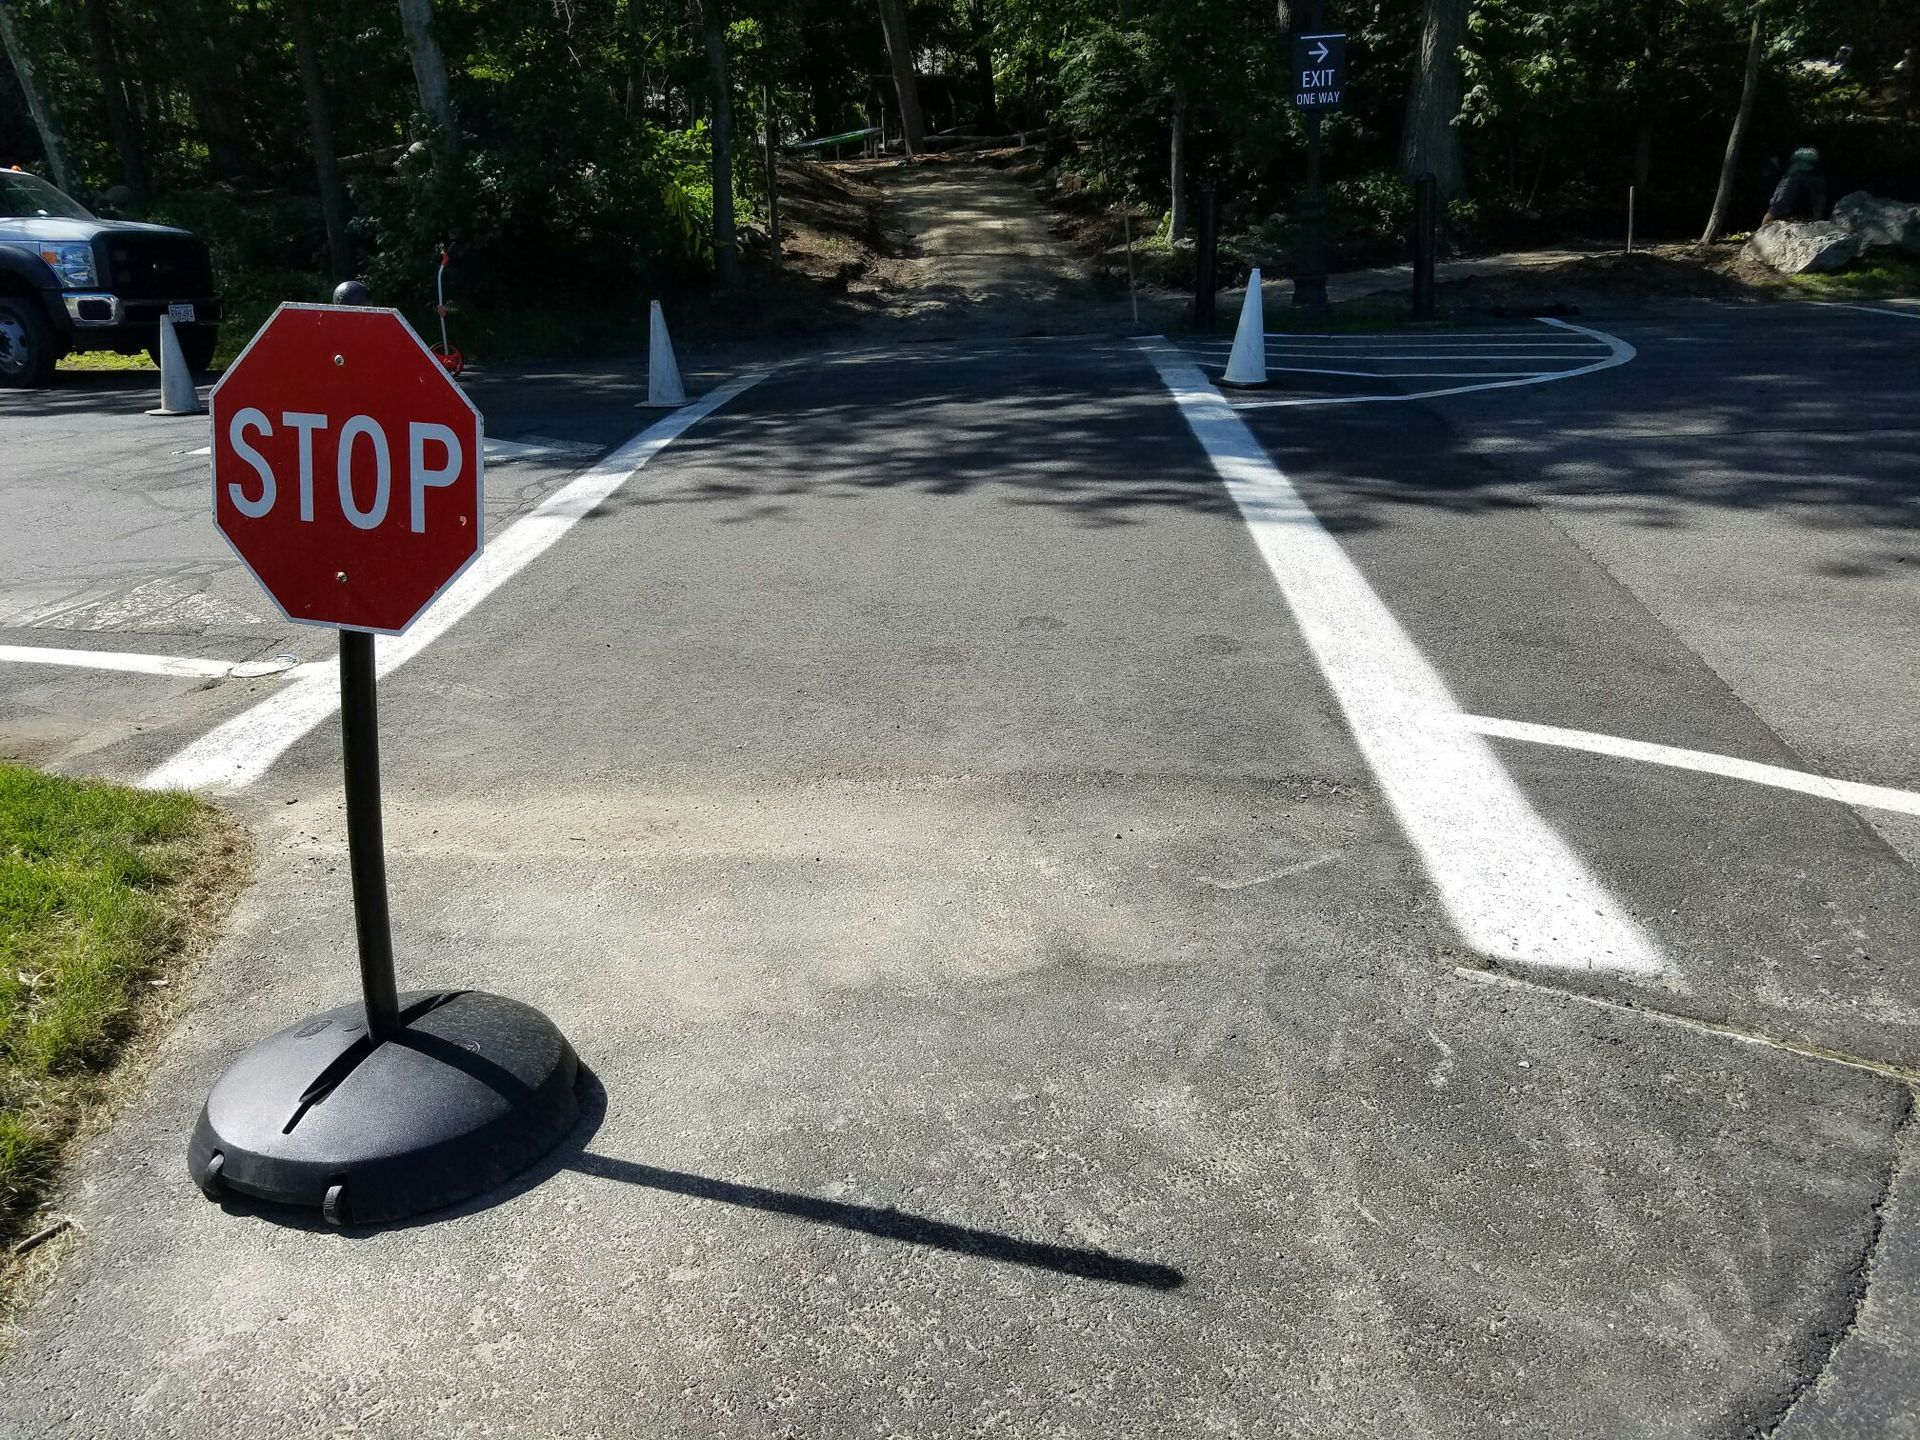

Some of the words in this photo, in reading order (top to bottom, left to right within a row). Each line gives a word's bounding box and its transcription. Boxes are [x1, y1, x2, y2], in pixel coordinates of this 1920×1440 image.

[1302, 69, 1335, 88] EXIT
[1296, 93, 1316, 105] ONE
[1318, 91, 1340, 104] WAY
[228, 407, 463, 533] STOP
